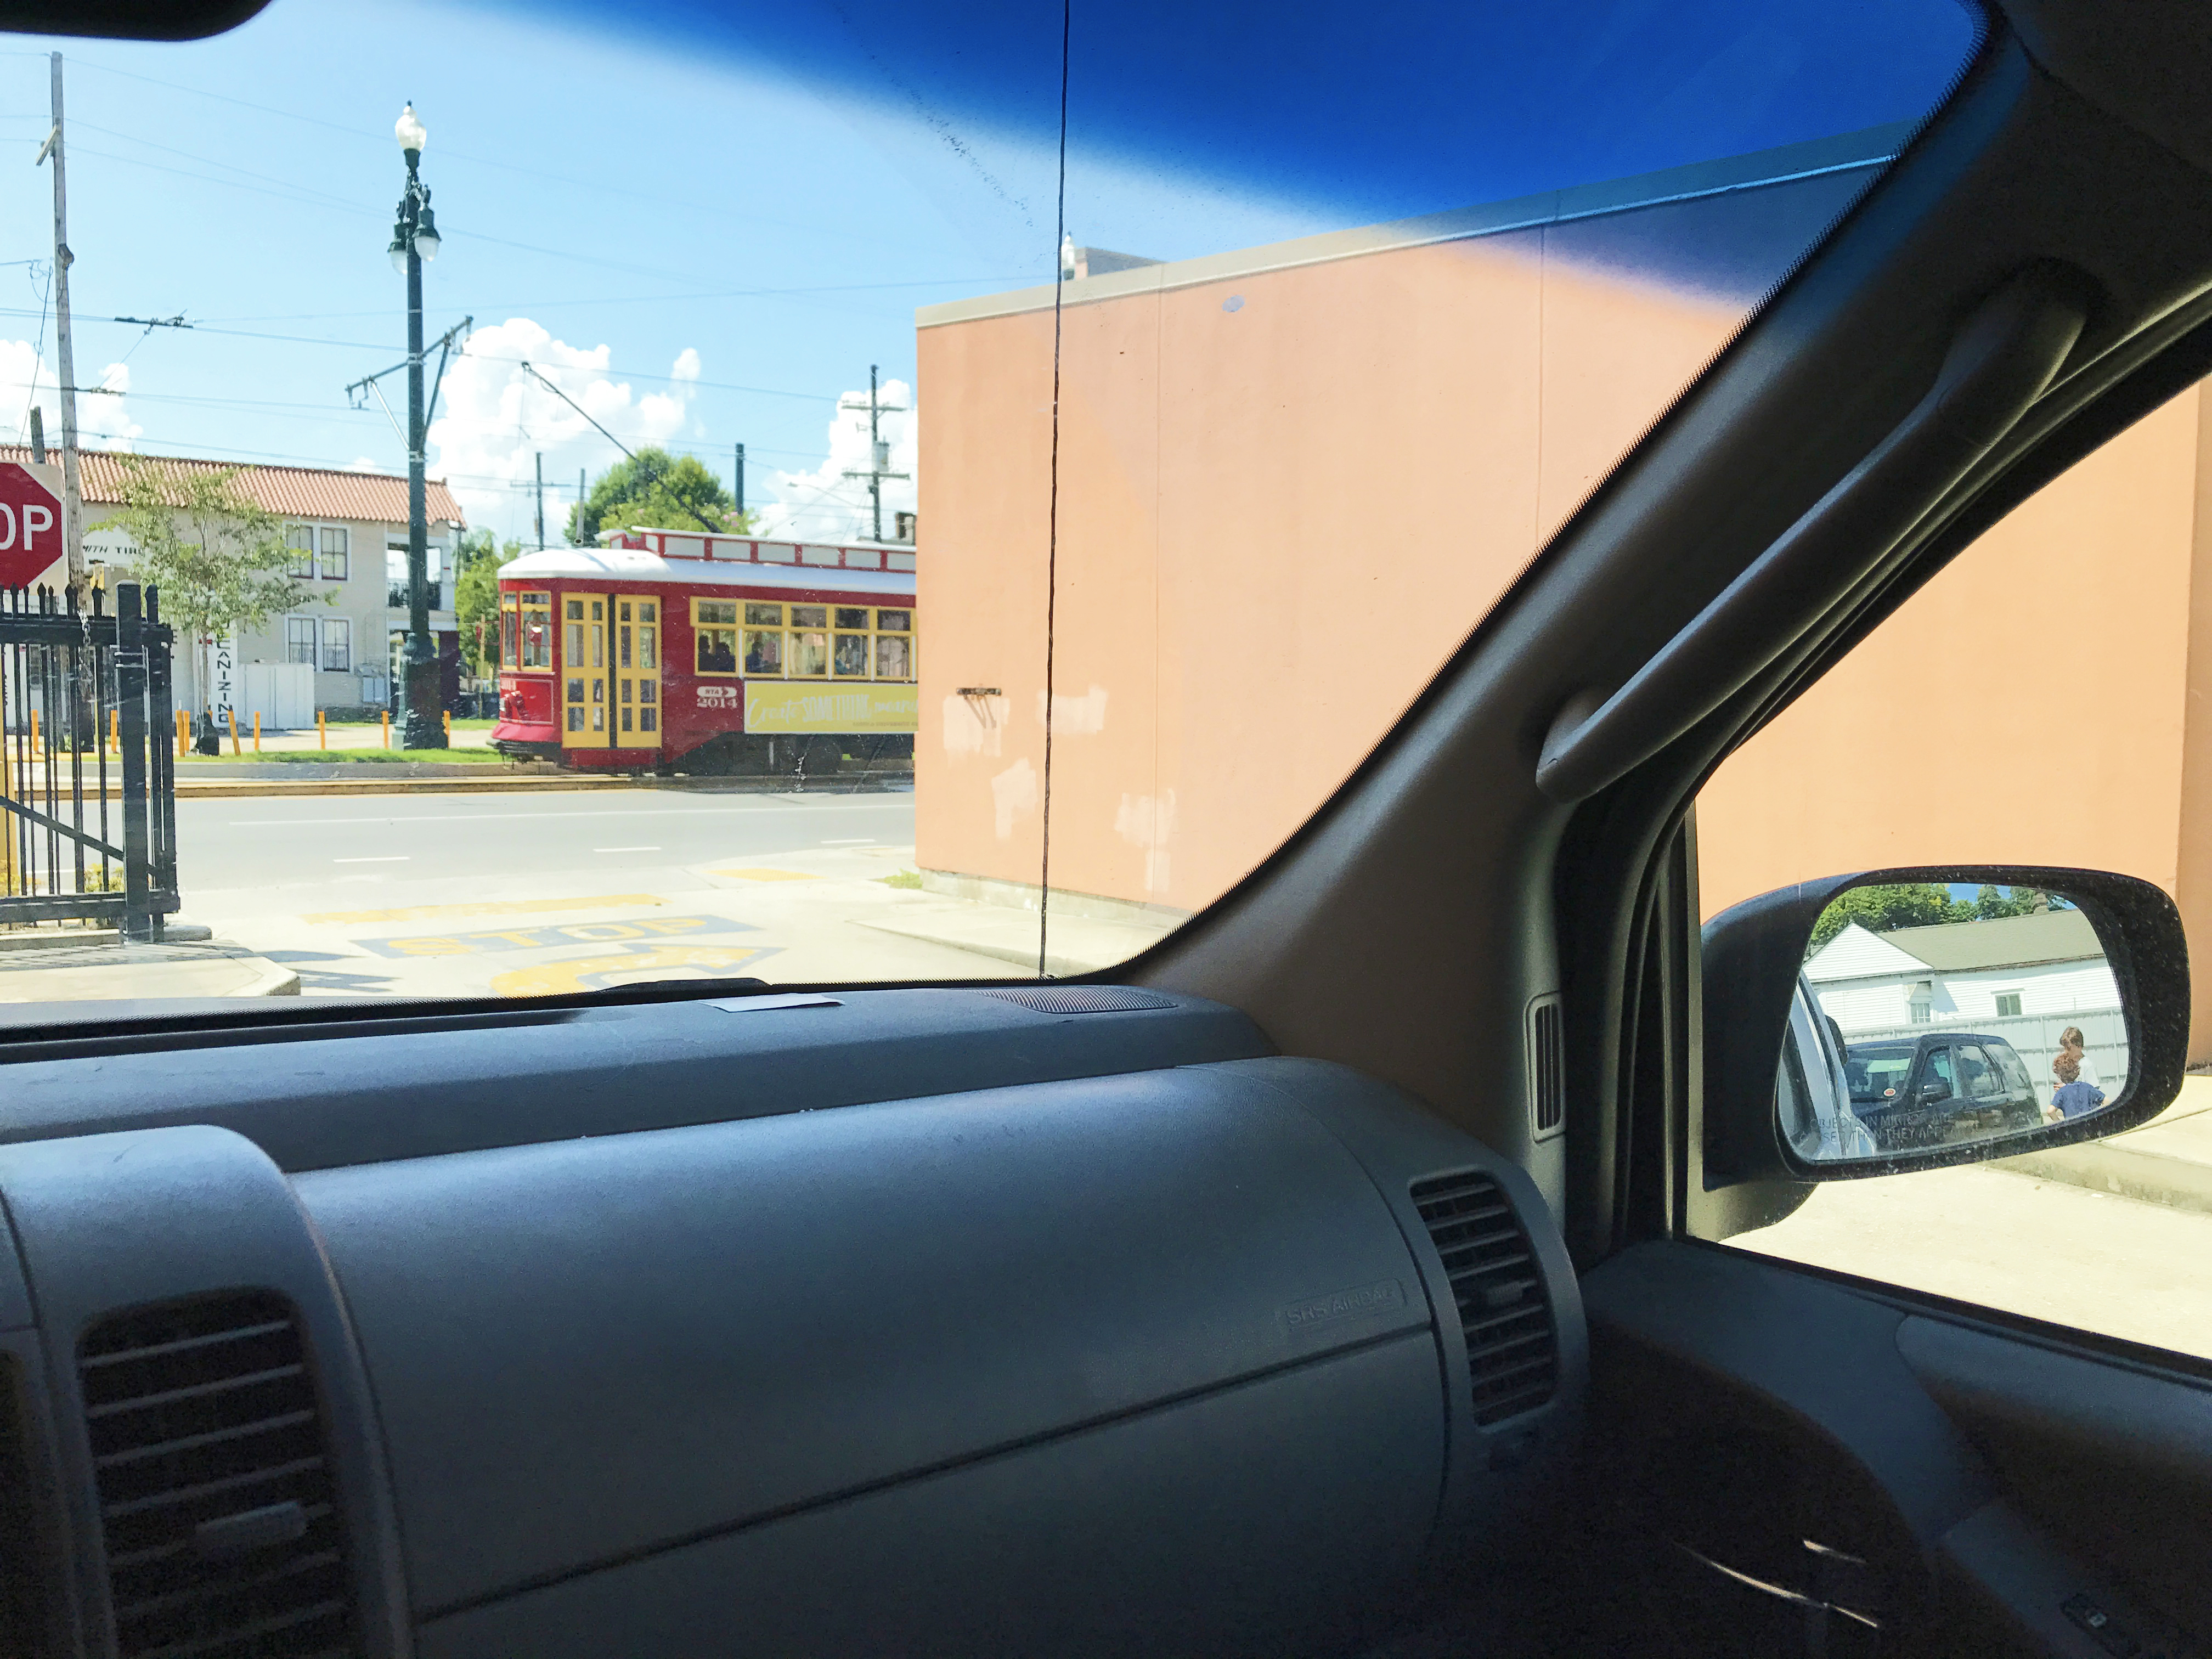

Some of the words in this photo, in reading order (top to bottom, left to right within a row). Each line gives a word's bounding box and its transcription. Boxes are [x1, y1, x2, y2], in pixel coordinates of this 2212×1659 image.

[696, 697, 737, 708] 2014
[747, 698, 800, 728] Create
[802, 693, 872, 722] SOMETHING
[387, 918, 708, 955] STOP
[1866, 1115, 1878, 1127] IN
[1885, 1126, 1915, 1140] THEY
[1331, 1285, 1396, 1313] AIRBAG
